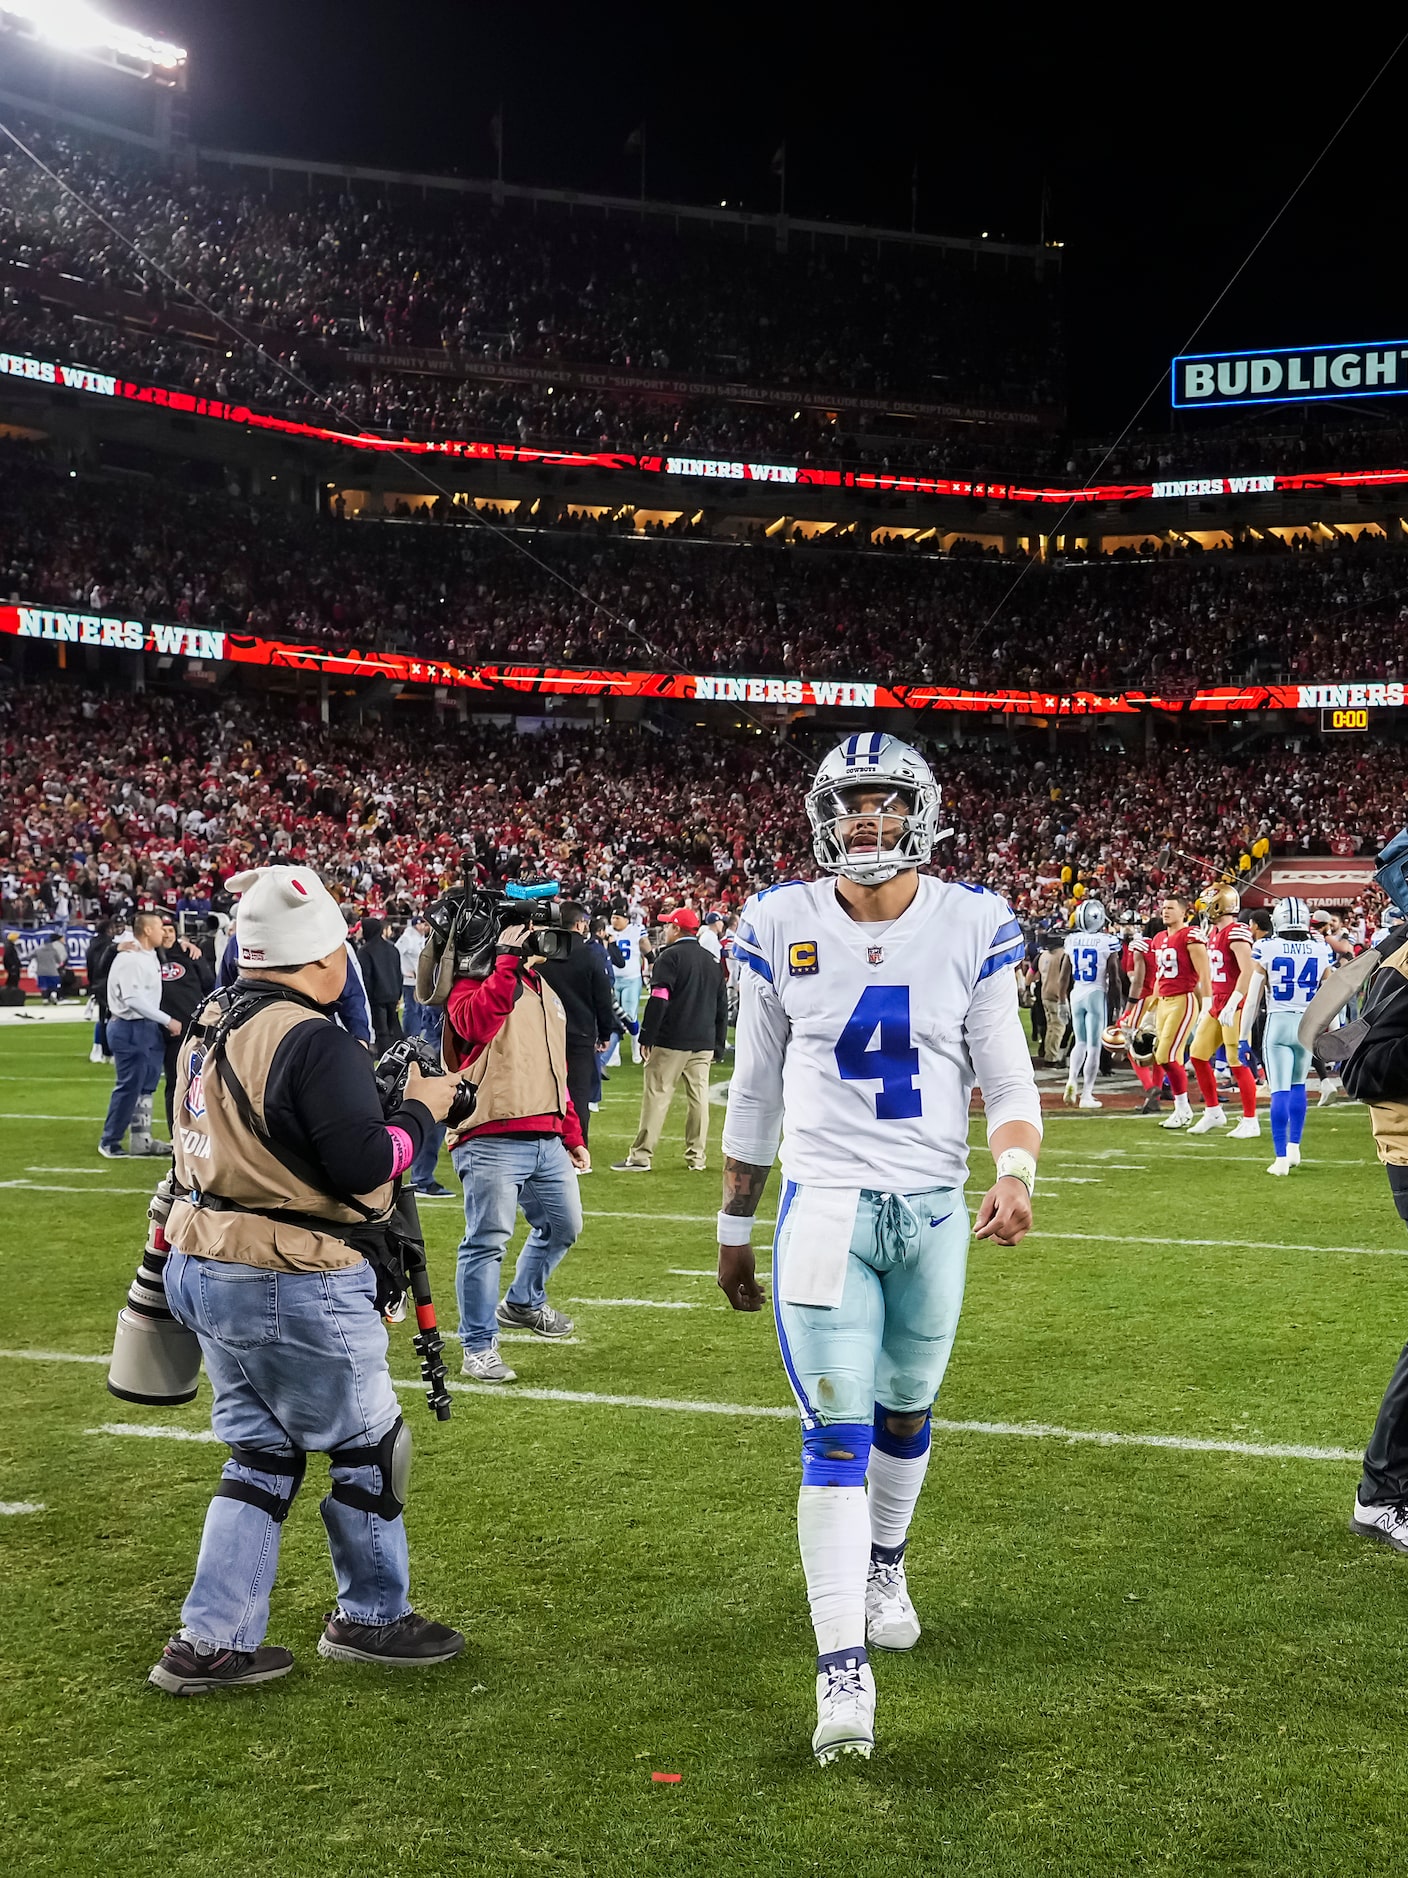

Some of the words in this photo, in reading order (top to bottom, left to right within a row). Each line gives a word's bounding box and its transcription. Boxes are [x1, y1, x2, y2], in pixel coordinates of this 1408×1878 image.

[60, 365, 116, 396] WIN
[345, 352, 376, 364] FREE
[381, 355, 424, 369] XFINITY
[464, 362, 495, 374] NEED
[498, 366, 572, 381] ASSISTANCE?
[579, 374, 607, 384] TEXT
[673, 382, 687, 393] TO
[814, 394, 860, 408] INCLUDE
[966, 409, 987, 418] AND
[667, 458, 744, 479] NINERS
[748, 464, 797, 483] WIN
[1152, 480, 1223, 498] NINERS
[1228, 476, 1276, 493] WIN
[16, 607, 143, 650] NINERS
[151, 624, 226, 660] WIN
[694, 677, 803, 704] NINERS
[810, 682, 877, 707] WIN
[1297, 683, 1404, 708] NINERS
[1333, 711, 1367, 728] 0:00
[1306, 897, 1353, 907] STADIUM
[792, 943, 816, 967] C
[1283, 944, 1312, 955] DAVIS
[1073, 948, 1098, 982] 13
[1271, 957, 1318, 1001] 34
[834, 985, 922, 1120] 4
